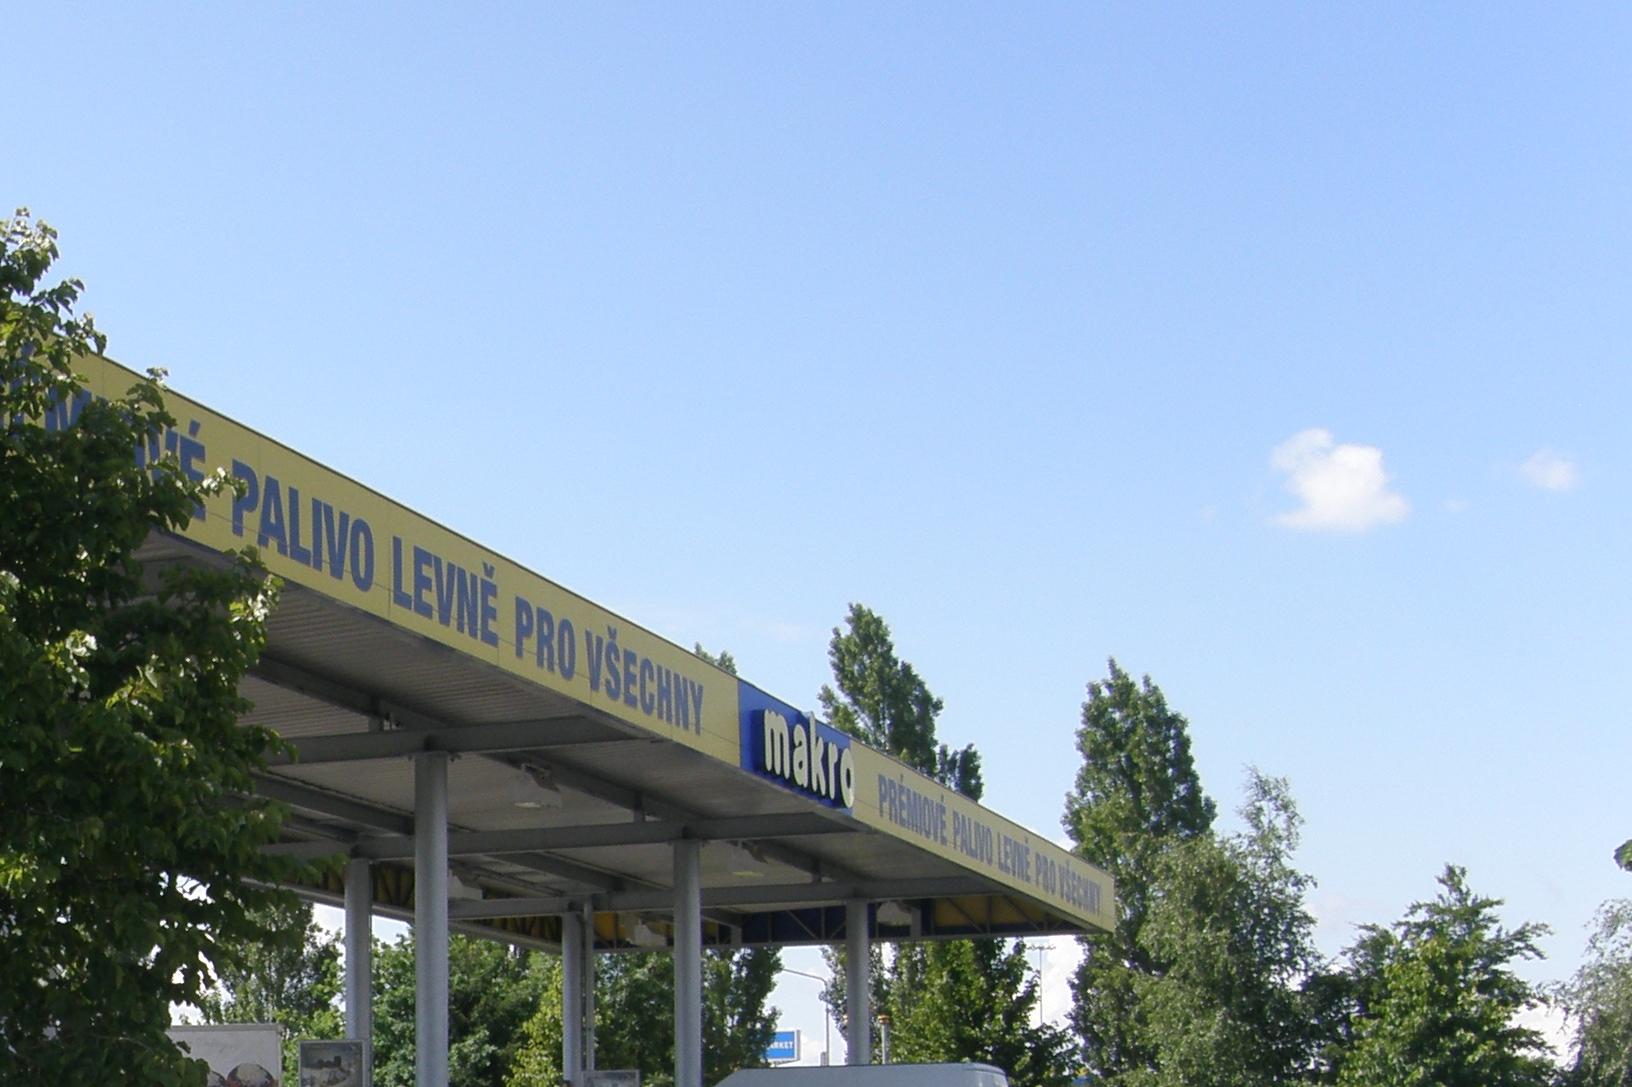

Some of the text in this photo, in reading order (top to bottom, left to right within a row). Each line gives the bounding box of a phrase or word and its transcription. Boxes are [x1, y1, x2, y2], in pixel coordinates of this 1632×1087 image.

[230, 457, 705, 736] PALIVO LEVNĚ PRO VŠECHNY
[764, 708, 855, 808] makro
[877, 773, 948, 846] PRÉMIOVÉ
[952, 810, 993, 866] PALIVO
[1035, 852, 1056, 896] PRO
